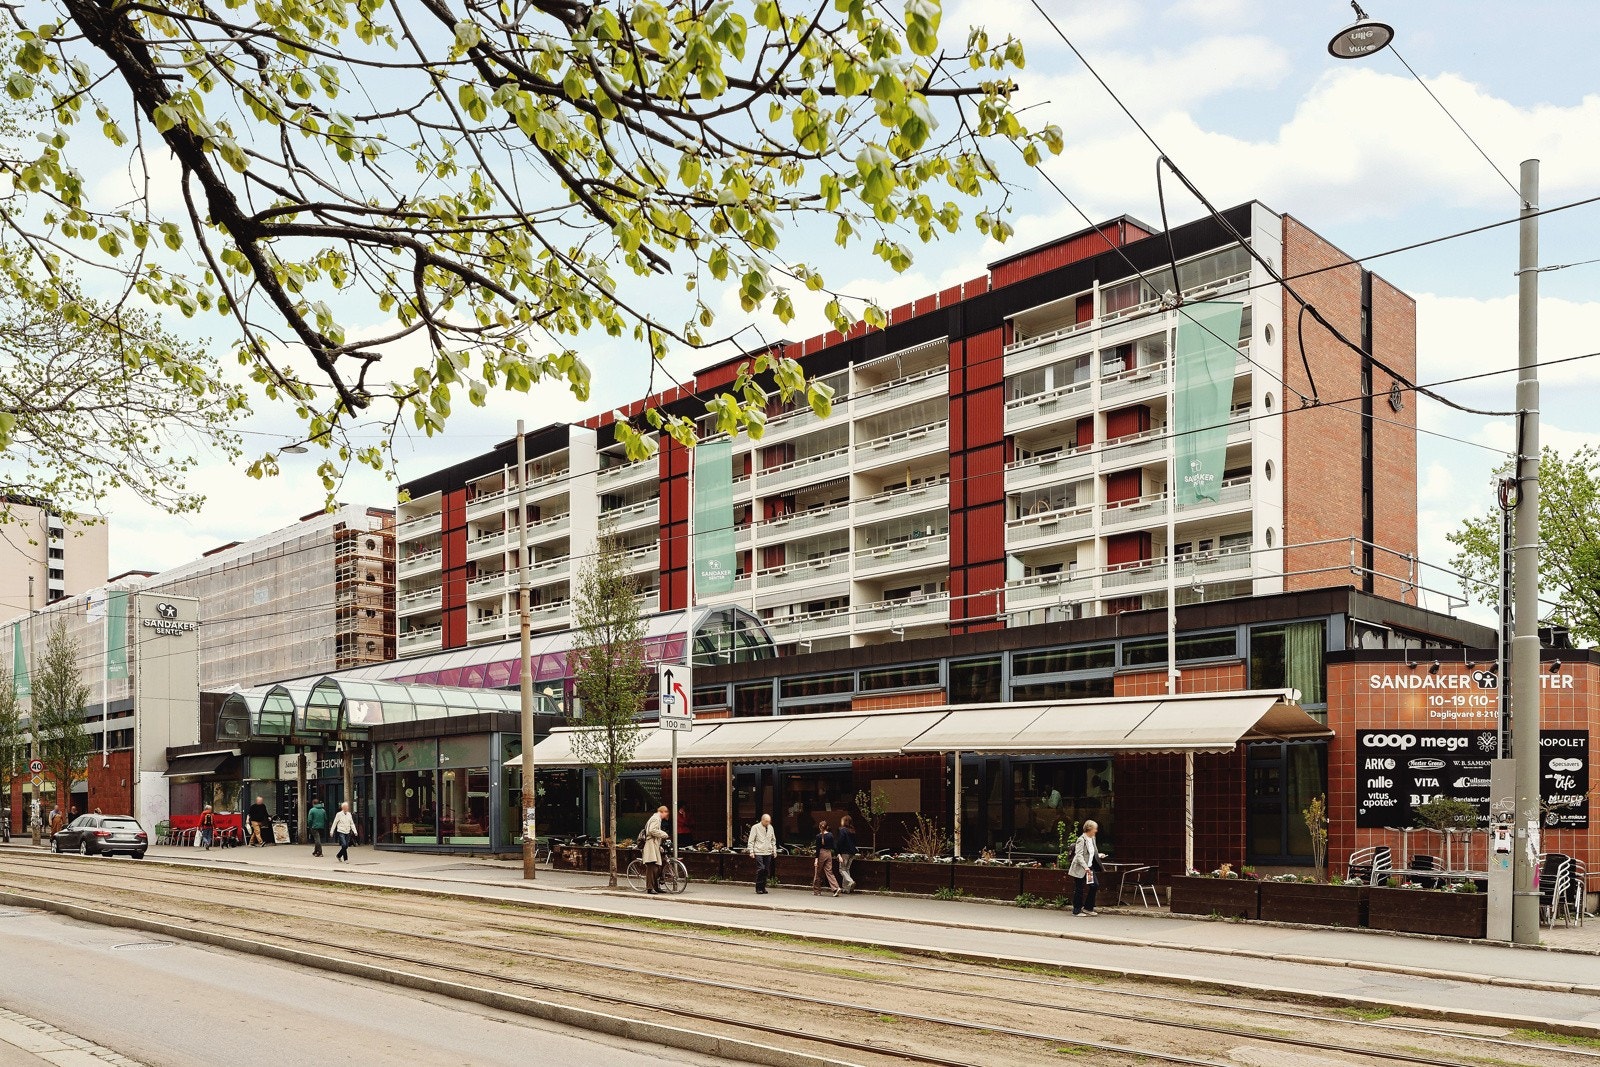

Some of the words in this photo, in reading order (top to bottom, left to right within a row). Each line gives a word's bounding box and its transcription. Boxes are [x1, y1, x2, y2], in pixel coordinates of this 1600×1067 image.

[143, 618, 196, 632] SANDAKER
[155, 627, 184, 636] SENTER
[1369, 674, 1471, 690] SANDAKER
[1538, 674, 1574, 690] TER
[1430, 710, 1475, 720] Dagligvare
[666, 720, 678, 729] 100
[1362, 733, 1417, 751] coop
[1420, 737, 1469, 752] mega
[31, 762, 43, 771] 40
[1364, 758, 1385, 770] ARK
[1367, 775, 1394, 789] nille
[1414, 778, 1440, 787] VITA
[1368, 792, 1389, 800] vitus
